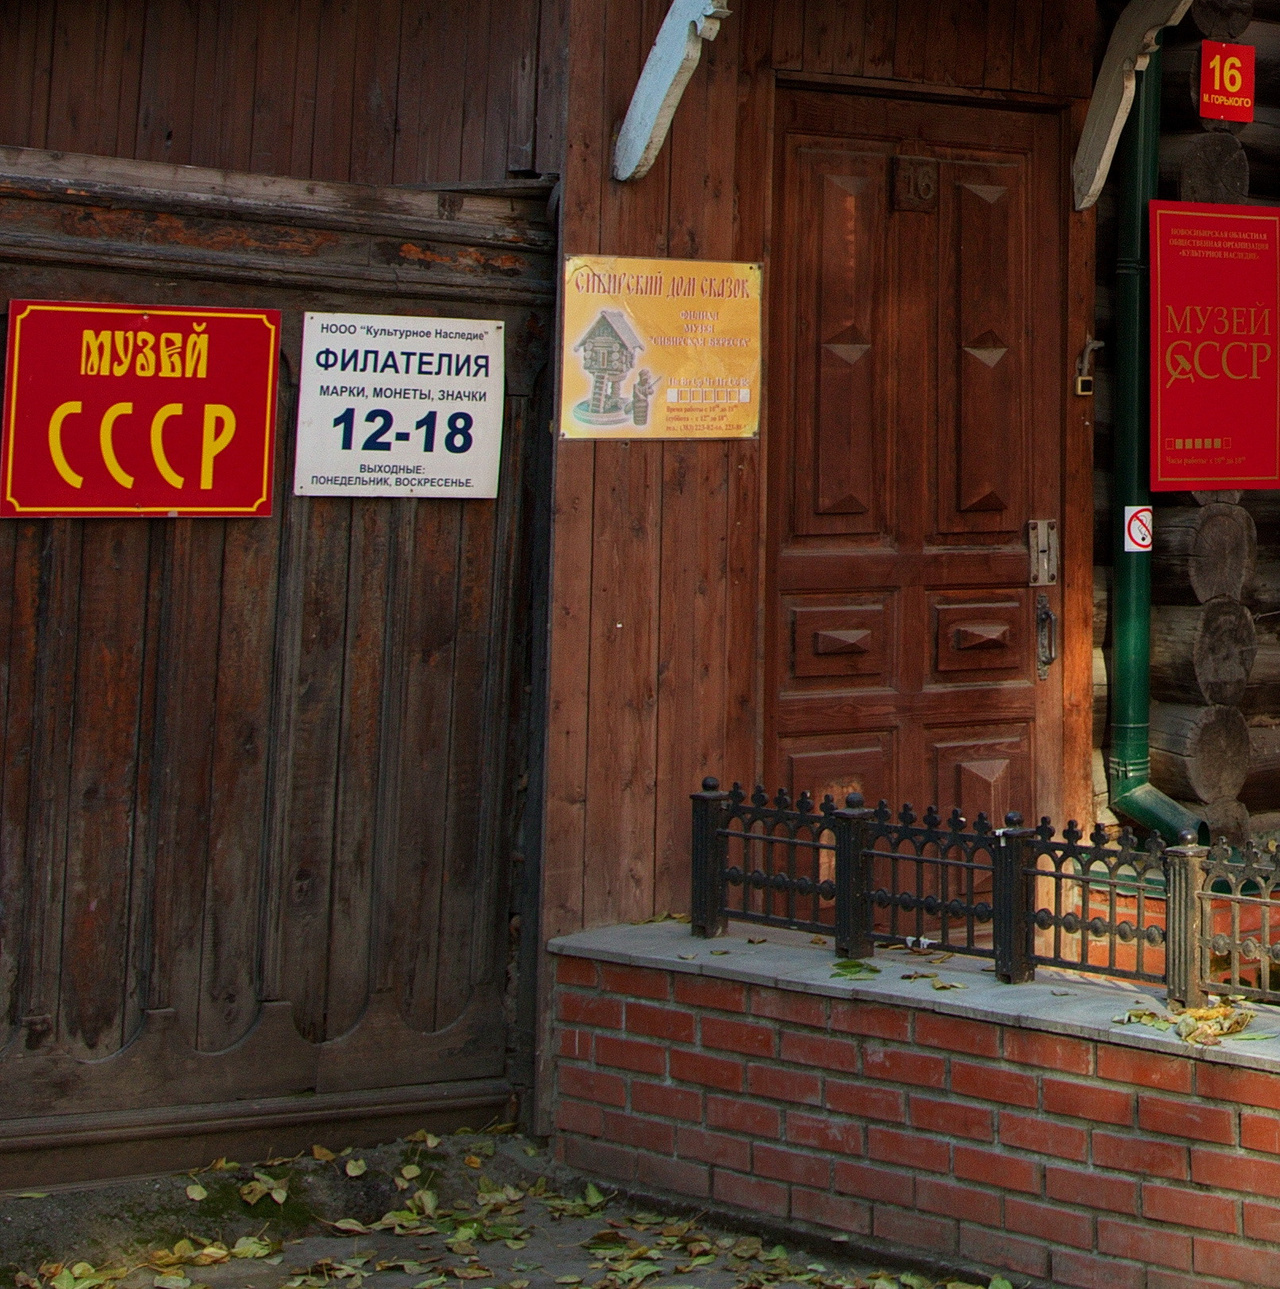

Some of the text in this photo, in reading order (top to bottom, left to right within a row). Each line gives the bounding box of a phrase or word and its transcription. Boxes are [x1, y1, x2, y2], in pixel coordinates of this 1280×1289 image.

[1209, 54, 1243, 92] 16
[1210, 94, 1252, 108] ГОРЬКОГО
[575, 271, 750, 300] СИБИРСКИЙ ДОМ СКАЗОК
[321, 323, 357, 335] НООО
[1165, 302, 1271, 336] МУЗЕЙ
[80, 323, 209, 378] МУЗЕЙ
[315, 348, 490, 378] ФИЛАТЕЛИЯ
[1165, 340, 1272, 382] СССР
[319, 385, 487, 402] МАРКИ, МОНЕТЫ, ЗНАЧКИ
[47, 400, 237, 491] СССР
[333, 408, 473, 453] 12-18
[311, 475, 474, 488] ПОНЕДЕЛЬНИК, ВОСКРЕСЕНЬЕ.
[359, 464, 426, 475] ВЫХОДНЫЕ:
